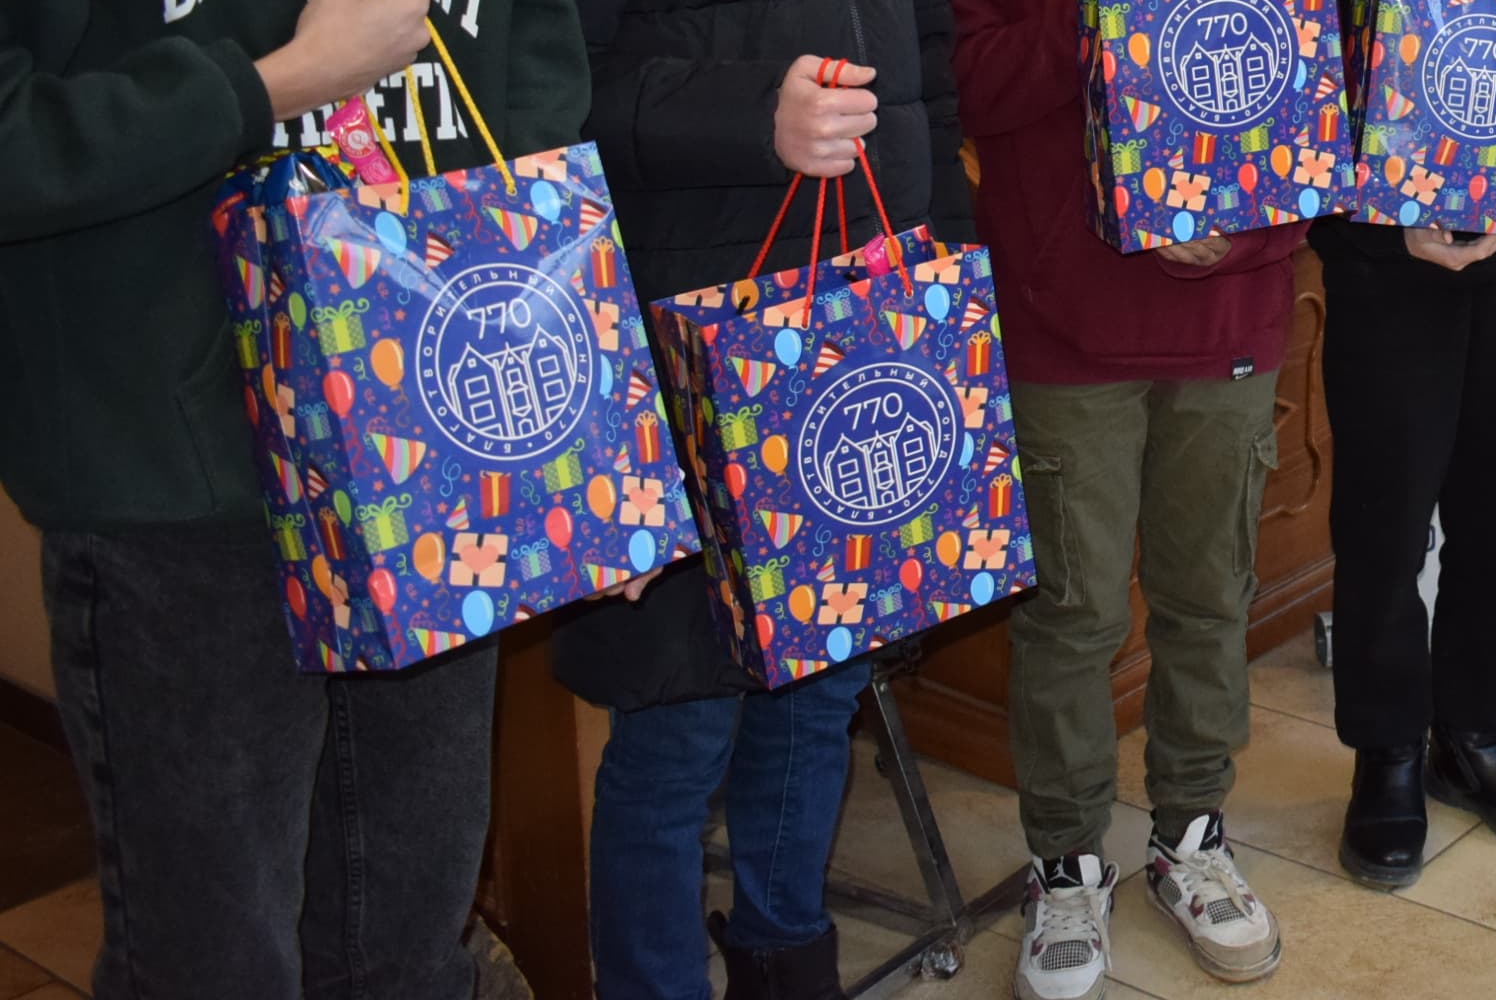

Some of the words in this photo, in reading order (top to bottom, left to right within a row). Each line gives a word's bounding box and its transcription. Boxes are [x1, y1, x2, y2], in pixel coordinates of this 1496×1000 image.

[1197, 12, 1248, 40] 770
[467, 298, 531, 339] 770
[567, 313, 587, 384] ФОНД
[843, 392, 903, 430] 770
